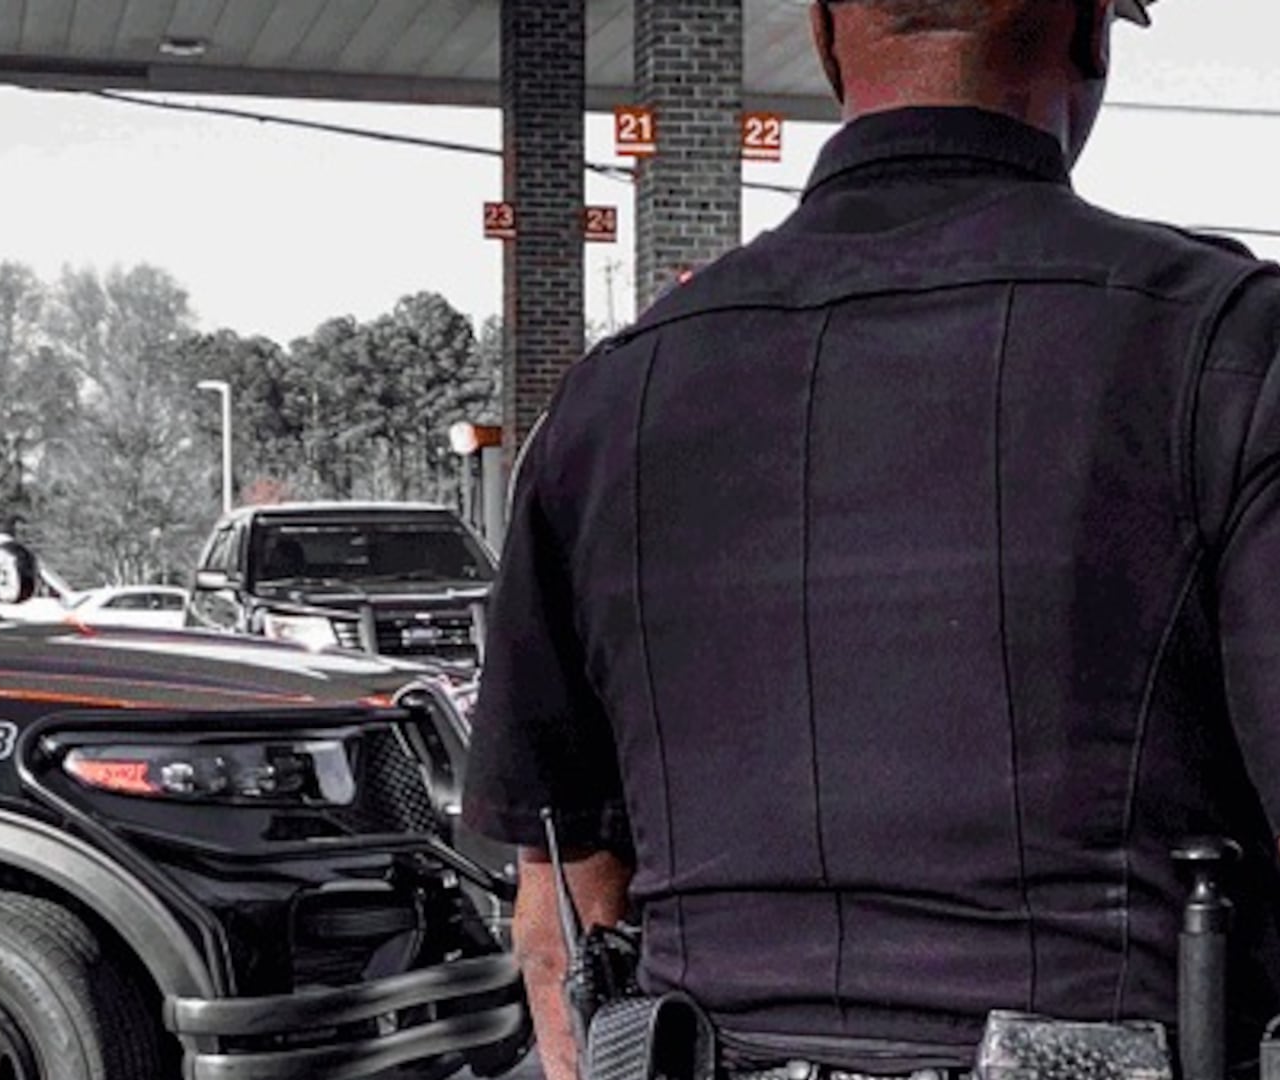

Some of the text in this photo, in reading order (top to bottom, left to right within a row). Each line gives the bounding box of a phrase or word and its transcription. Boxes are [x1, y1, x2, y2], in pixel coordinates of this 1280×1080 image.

[619, 115, 652, 141] 21
[745, 118, 780, 147] 22
[484, 203, 515, 227] 23
[586, 210, 616, 231] 24
